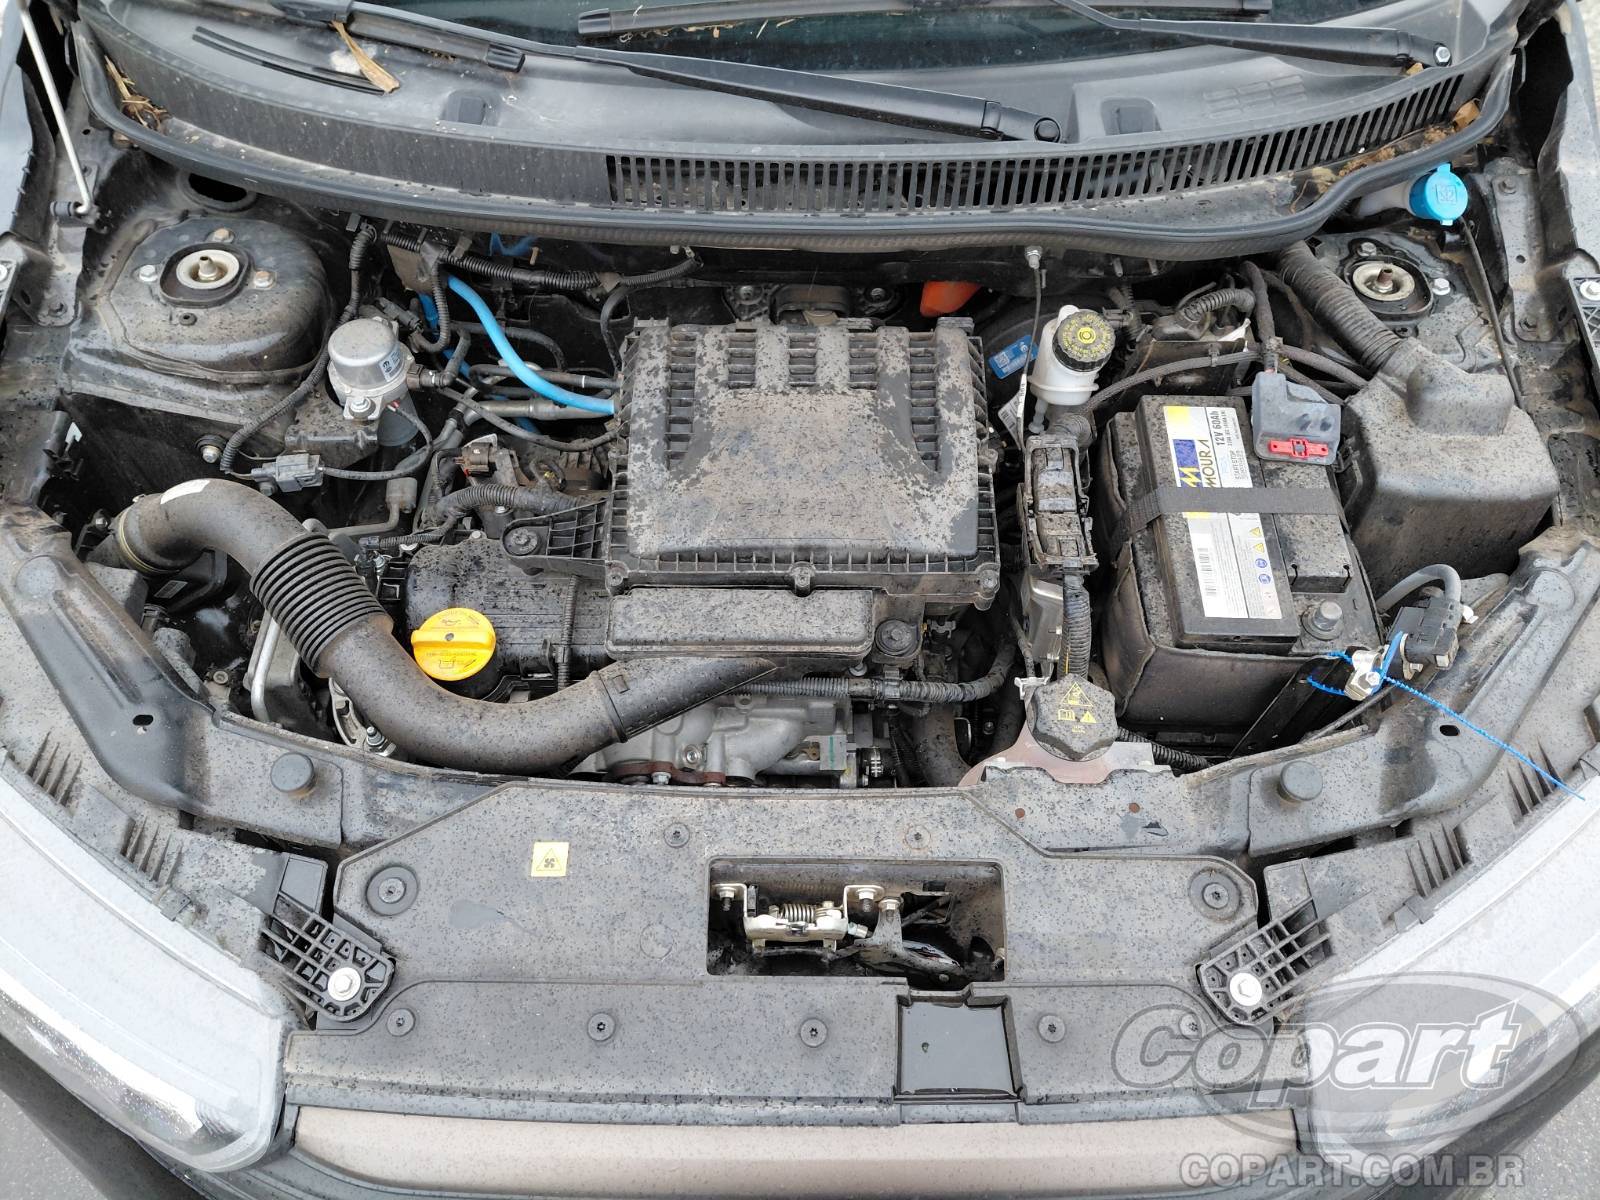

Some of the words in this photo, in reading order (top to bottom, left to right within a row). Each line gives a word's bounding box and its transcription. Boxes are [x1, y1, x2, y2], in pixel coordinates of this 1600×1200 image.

[1210, 411, 1221, 430] 60Ah
[1214, 432, 1225, 445] 12V
[1198, 440, 1216, 488] MOURA
